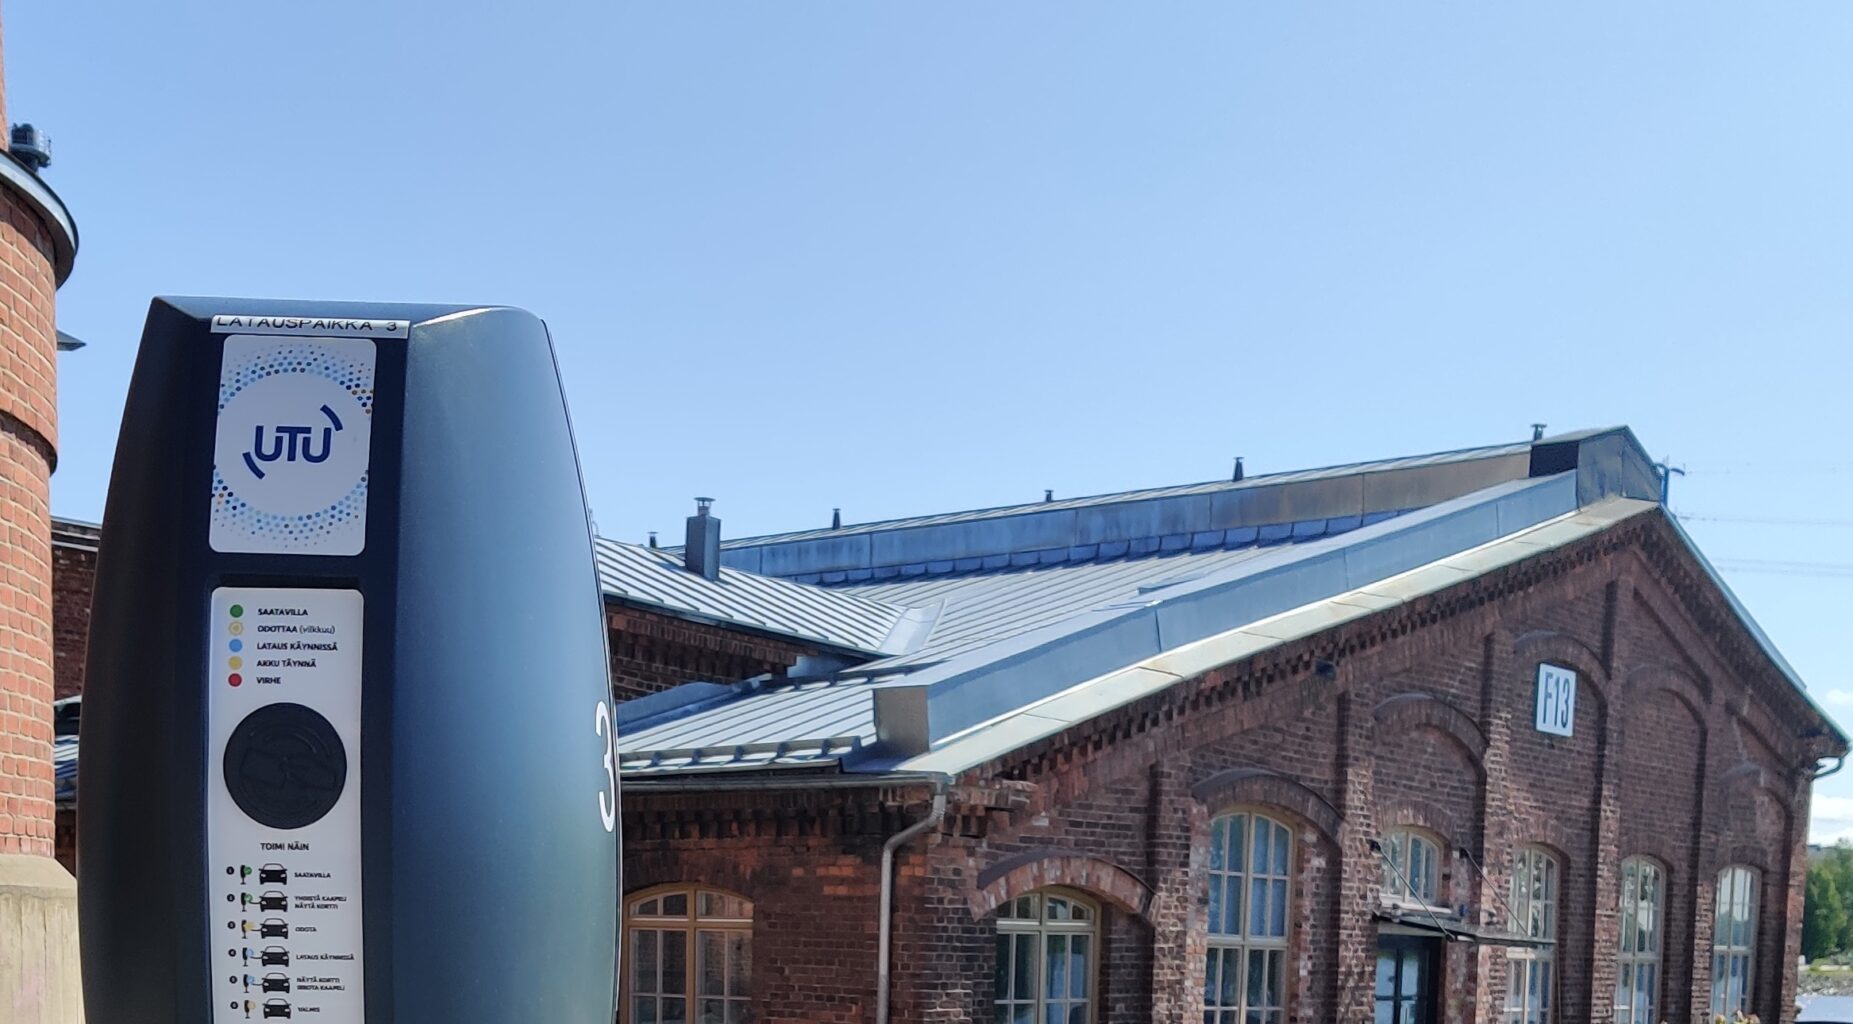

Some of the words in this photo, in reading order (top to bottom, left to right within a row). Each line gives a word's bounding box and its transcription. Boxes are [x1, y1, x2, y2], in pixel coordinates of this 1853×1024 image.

[386, 321, 398, 332] 3
[254, 425, 332, 463] UTU
[257, 608, 309, 616] SAATAVILLA
[257, 625, 298, 633] ODOTTAA
[256, 642, 288, 650] LATAUS
[282, 658, 317, 668] TÄYNNÄ
[256, 676, 281, 684] VIRHE
[1543, 671, 1570, 728] F13
[260, 842, 286, 851] TOIMI
[287, 841, 310, 851] NÄIN
